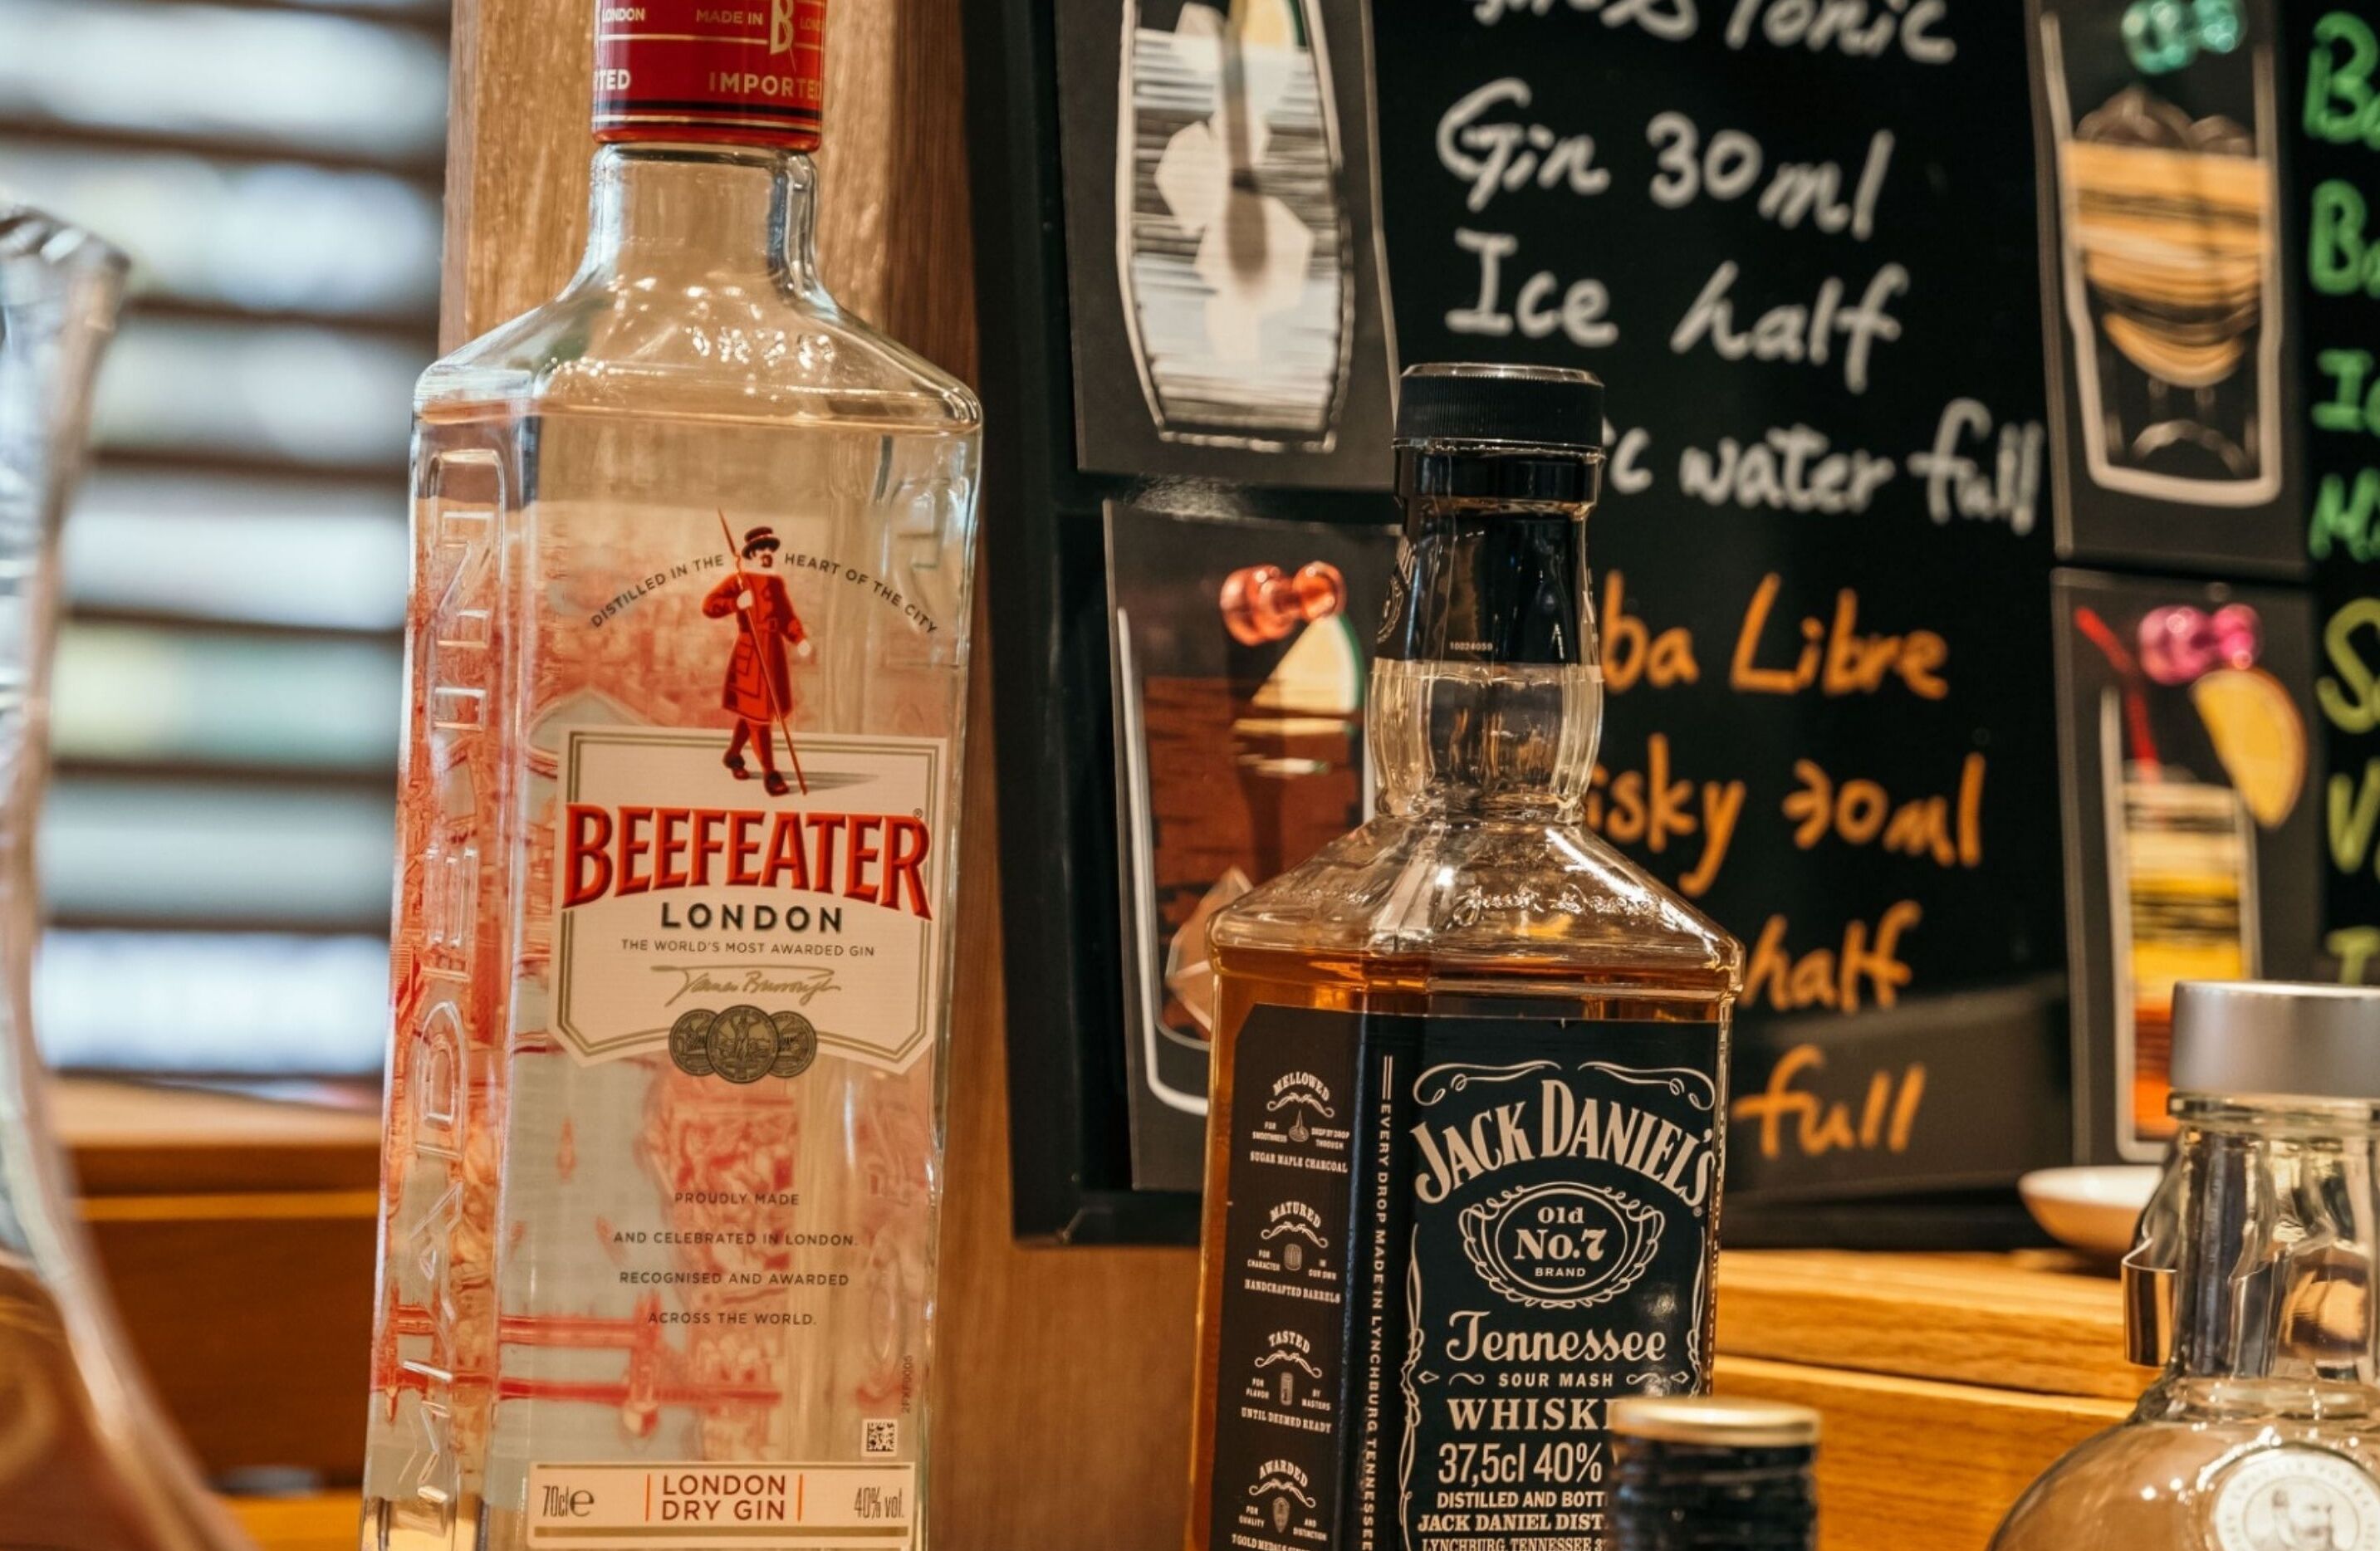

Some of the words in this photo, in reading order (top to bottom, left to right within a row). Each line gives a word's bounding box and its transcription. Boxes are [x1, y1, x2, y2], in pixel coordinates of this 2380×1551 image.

[697, 9, 742, 23] MADE
[748, 12, 763, 25] IN
[1436, 76, 1611, 213] Gin
[1444, 227, 1619, 348] Ice
[1668, 260, 1910, 395] half
[1678, 423, 1896, 513] water
[1906, 398, 2045, 536] full
[591, 573, 666, 629] DISTILLED
[670, 563, 688, 580] IN
[692, 554, 725, 571] THE
[784, 552, 841, 575] HEART
[845, 569, 869, 585] OF
[873, 580, 902, 607] THE
[904, 604, 938, 634] CITY
[1730, 572, 1949, 700] Libre
[1587, 734, 1746, 897] isky
[561, 803, 933, 921] BEEFEATER
[660, 902, 843, 934] LONDON
[622, 938, 649, 952] THE
[654, 940, 720, 953] WORLD'S
[725, 942, 765, 954] MOST
[771, 944, 845, 957] AWARDED
[850, 946, 874, 957] GIN
[1739, 899, 1923, 1015] half
[1272, 1071, 1330, 1102] MELLOWED
[1731, 1043, 1927, 1159] full
[1379, 1103, 1392, 1167] EVERY
[1409, 1100, 1535, 1205] JACK
[1540, 1079, 1716, 1207] DANIEL'S
[1251, 1151, 1276, 1164] SUGAR
[1277, 1154, 1303, 1168] MAPLE
[1305, 1157, 1348, 1173] CHARCOAL
[674, 1192, 747, 1205] PROUDLY
[755, 1193, 800, 1206] MADE
[1376, 1172, 1388, 1223] DROP
[1270, 1201, 1321, 1228] MATURED
[1537, 1206, 1585, 1225] Old
[614, 1231, 647, 1244] AND
[654, 1231, 756, 1245] CELEBRATED
[762, 1233, 779, 1245] IN
[785, 1234, 858, 1246] LONDON.
[1374, 1230, 1386, 1285] MADE
[619, 1271, 722, 1284] RECOGNISED
[728, 1273, 762, 1284] AND
[768, 1274, 850, 1286] AWARDED
[1535, 1268, 1586, 1278] BRAND
[1244, 1279, 1301, 1298] HANDCRAFTED
[1303, 1288, 1341, 1304] BARRELS
[1372, 1289, 1385, 1309] IN
[648, 1312, 711, 1324] ACROSS
[717, 1313, 747, 1324] THE
[754, 1314, 817, 1326] WORLD.
[1268, 1330, 1310, 1353] TASTED
[1446, 1310, 1667, 1362] Tennessee
[1252, 1377, 1264, 1387] FOR
[1368, 1316, 1382, 1431] LYNCHBURG
[1498, 1373, 1550, 1388] SOUR
[1560, 1373, 1614, 1388] MASH
[1241, 1407, 1266, 1421] UNTIL
[1268, 1412, 1301, 1428] DEEMED
[1303, 1419, 1332, 1434] READY
[1259, 1459, 1309, 1488] AWARDED
[1438, 1443, 1525, 1488] 37,5cl
[1533, 1442, 1603, 1484] 40%
[663, 1475, 786, 1496] LONDON
[1362, 1440, 1378, 1551] TENNESSEE
[662, 1500, 721, 1521] DRY
[733, 1500, 785, 1521] GIN
[854, 1486, 881, 1519] 40%
[884, 1488, 904, 1519] vol.
[1246, 1505, 1259, 1515] FOR
[1437, 1492, 1519, 1509] DISTILLED
[1522, 1491, 1558, 1508] AND
[1561, 1491, 1609, 1507] BOTT
[1418, 1514, 1472, 1532] JACK
[1474, 1514, 1552, 1531] DANIEL
